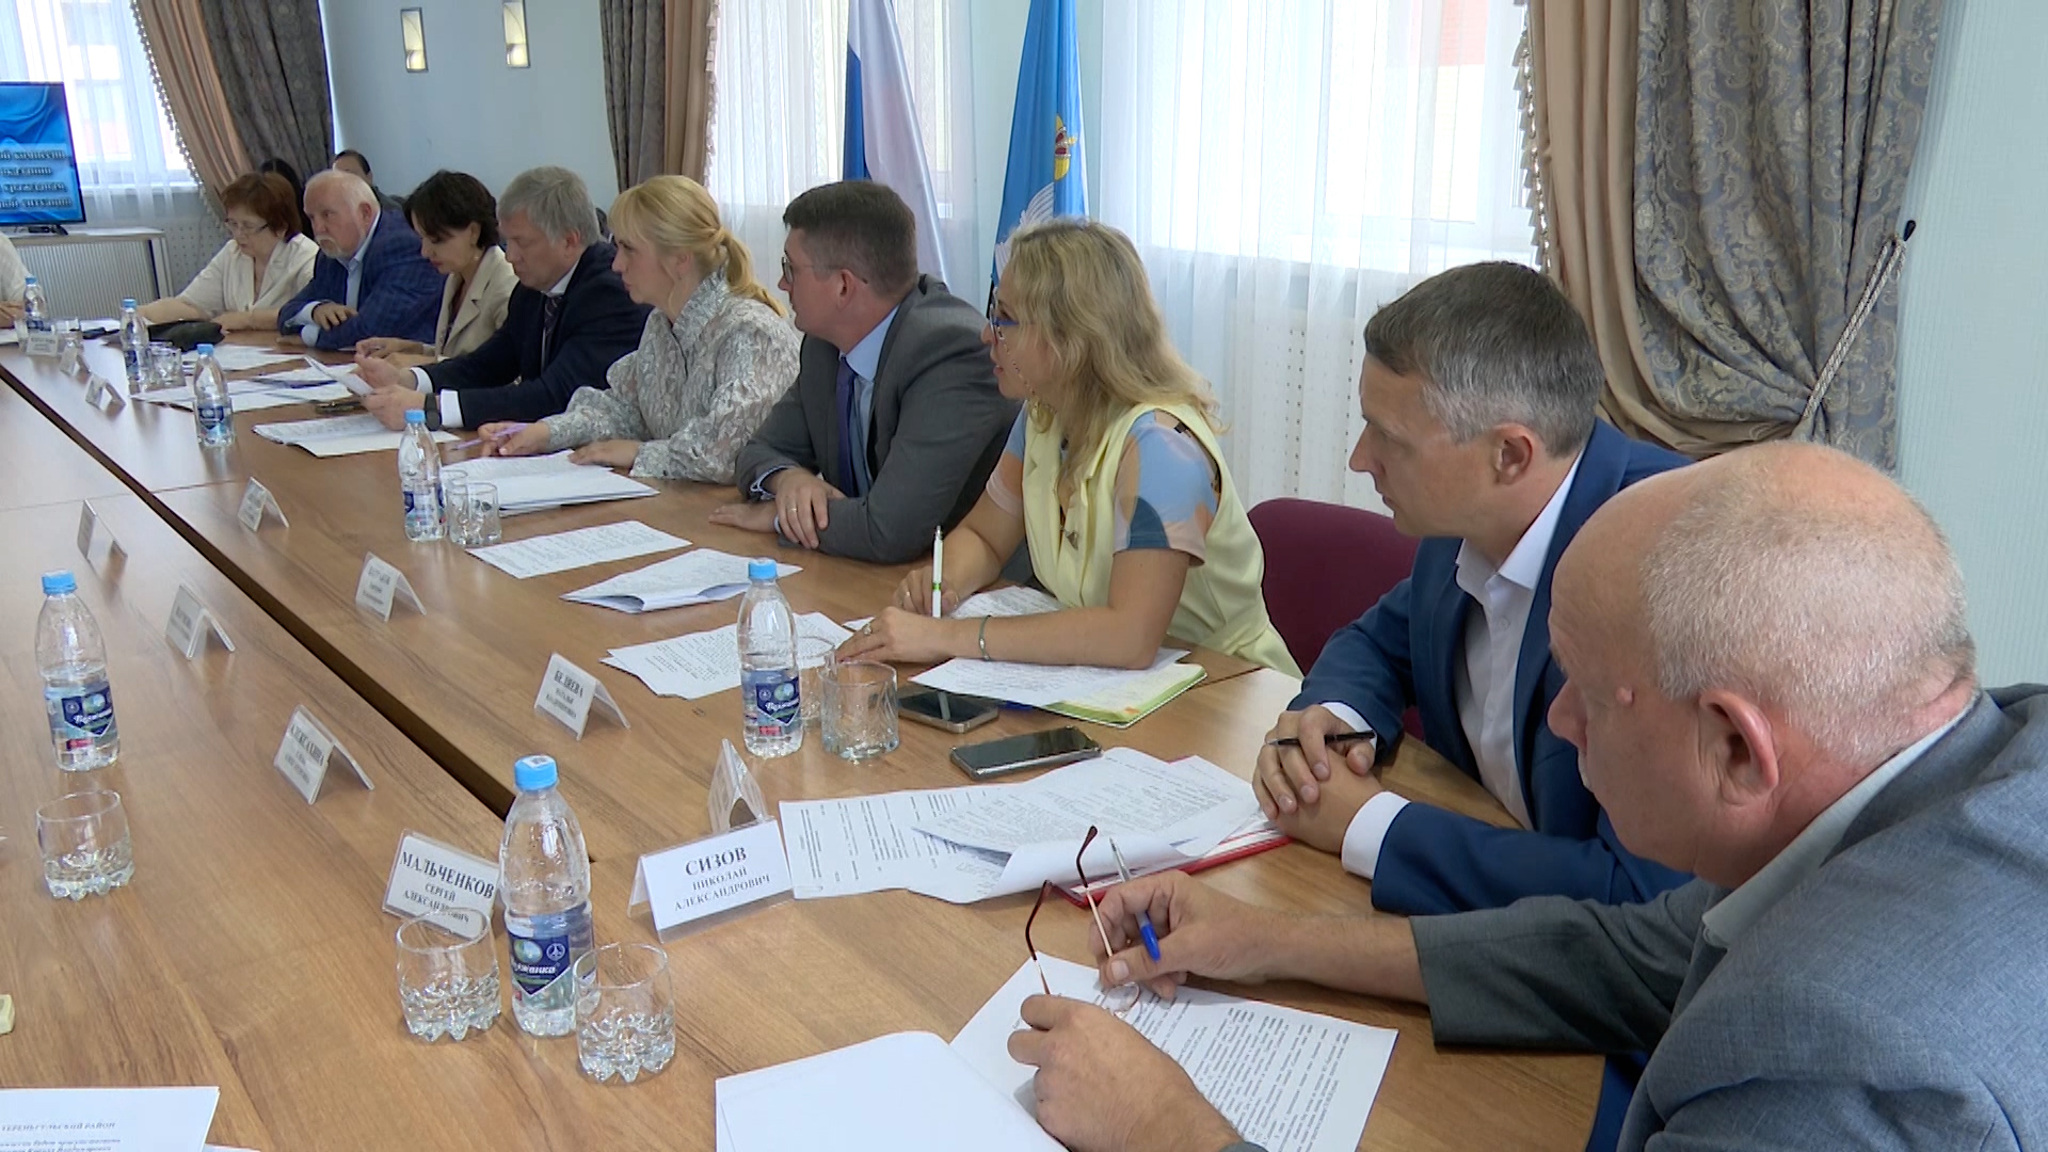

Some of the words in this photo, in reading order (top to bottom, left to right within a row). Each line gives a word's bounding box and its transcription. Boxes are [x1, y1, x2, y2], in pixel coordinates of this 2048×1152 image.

[399, 851, 495, 899] МАЛЬЧЕНКОВ
[685, 847, 747, 876] СИЗОВ
[692, 866, 748, 891] НИКОЛАЙ
[424, 883, 457, 903] СЕРГЕЙ
[674, 874, 771, 912] АЛЕКСАНДРОВИЧ
[84, 1121, 117, 1130] РАЙОН
